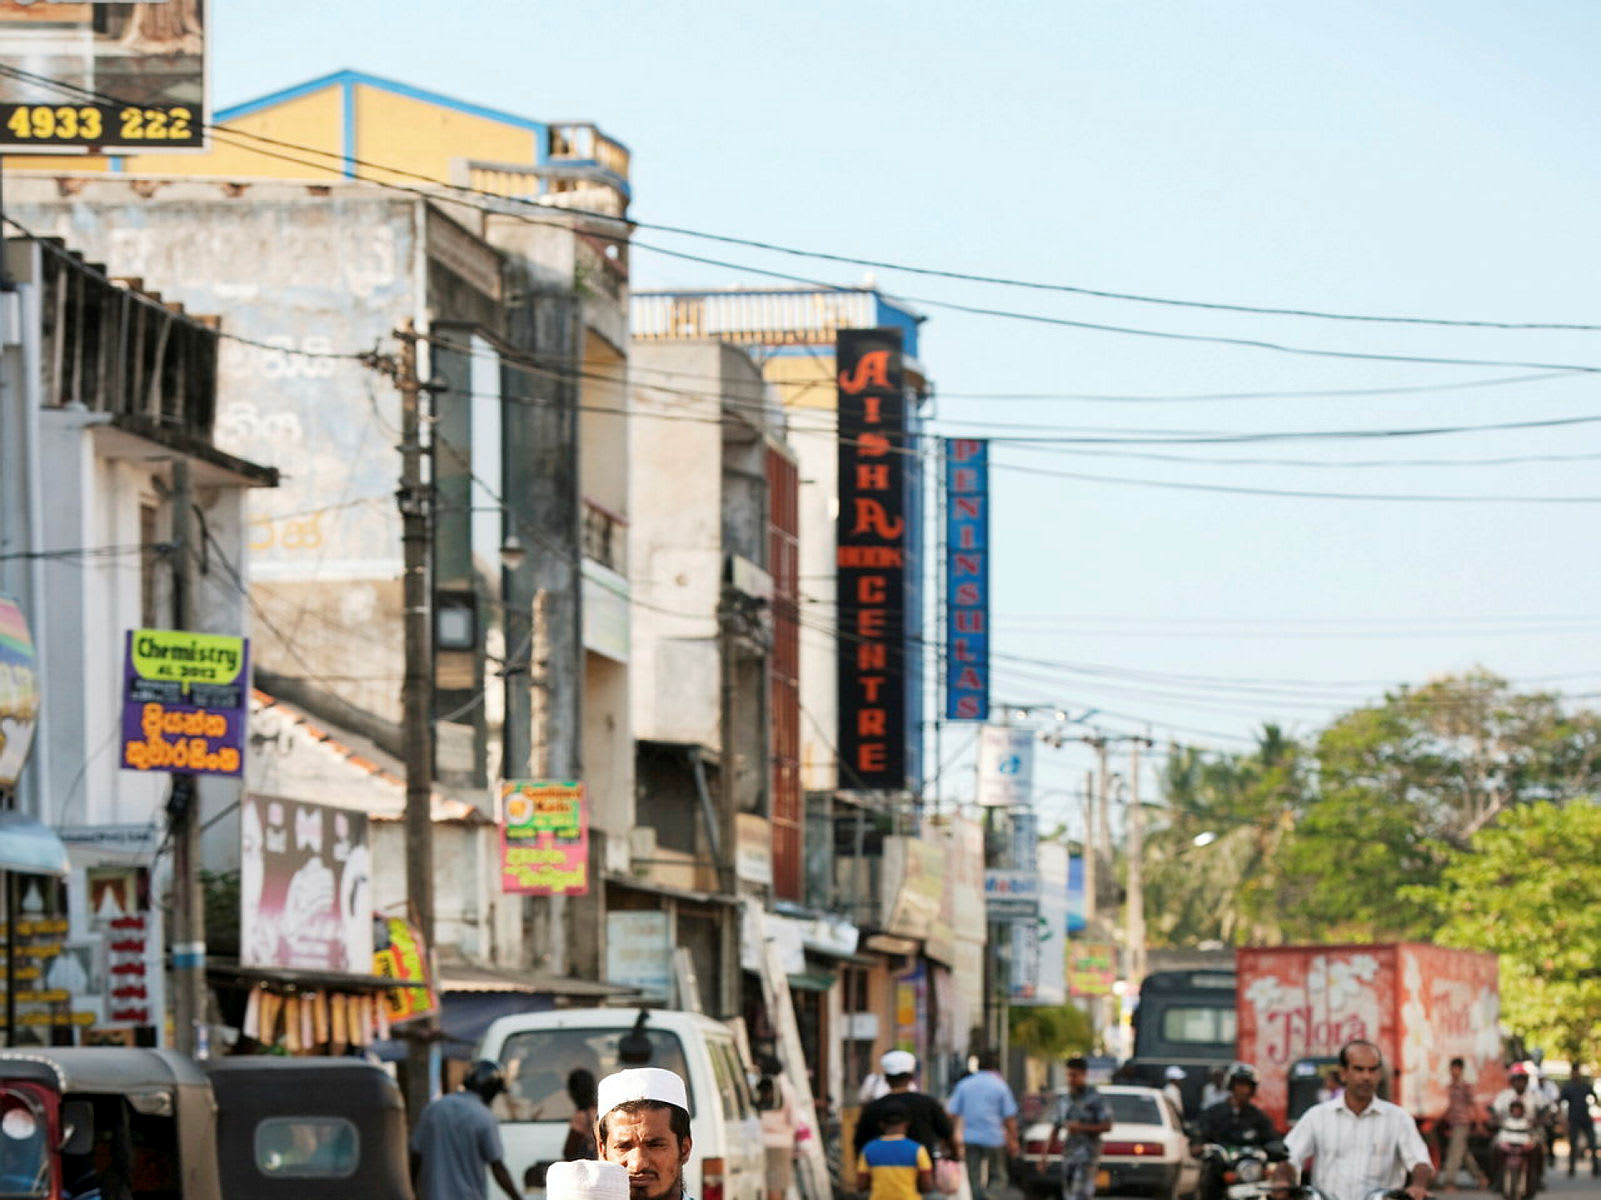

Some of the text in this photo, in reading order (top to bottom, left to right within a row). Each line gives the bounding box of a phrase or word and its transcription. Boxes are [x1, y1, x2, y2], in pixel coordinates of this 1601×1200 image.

[7, 106, 192, 139] 4933 222
[840, 349, 903, 538] AISHA
[138, 637, 237, 671] Chemistry
[857, 575, 886, 772] CENTRE
[1266, 1006, 1368, 1065] Flora
